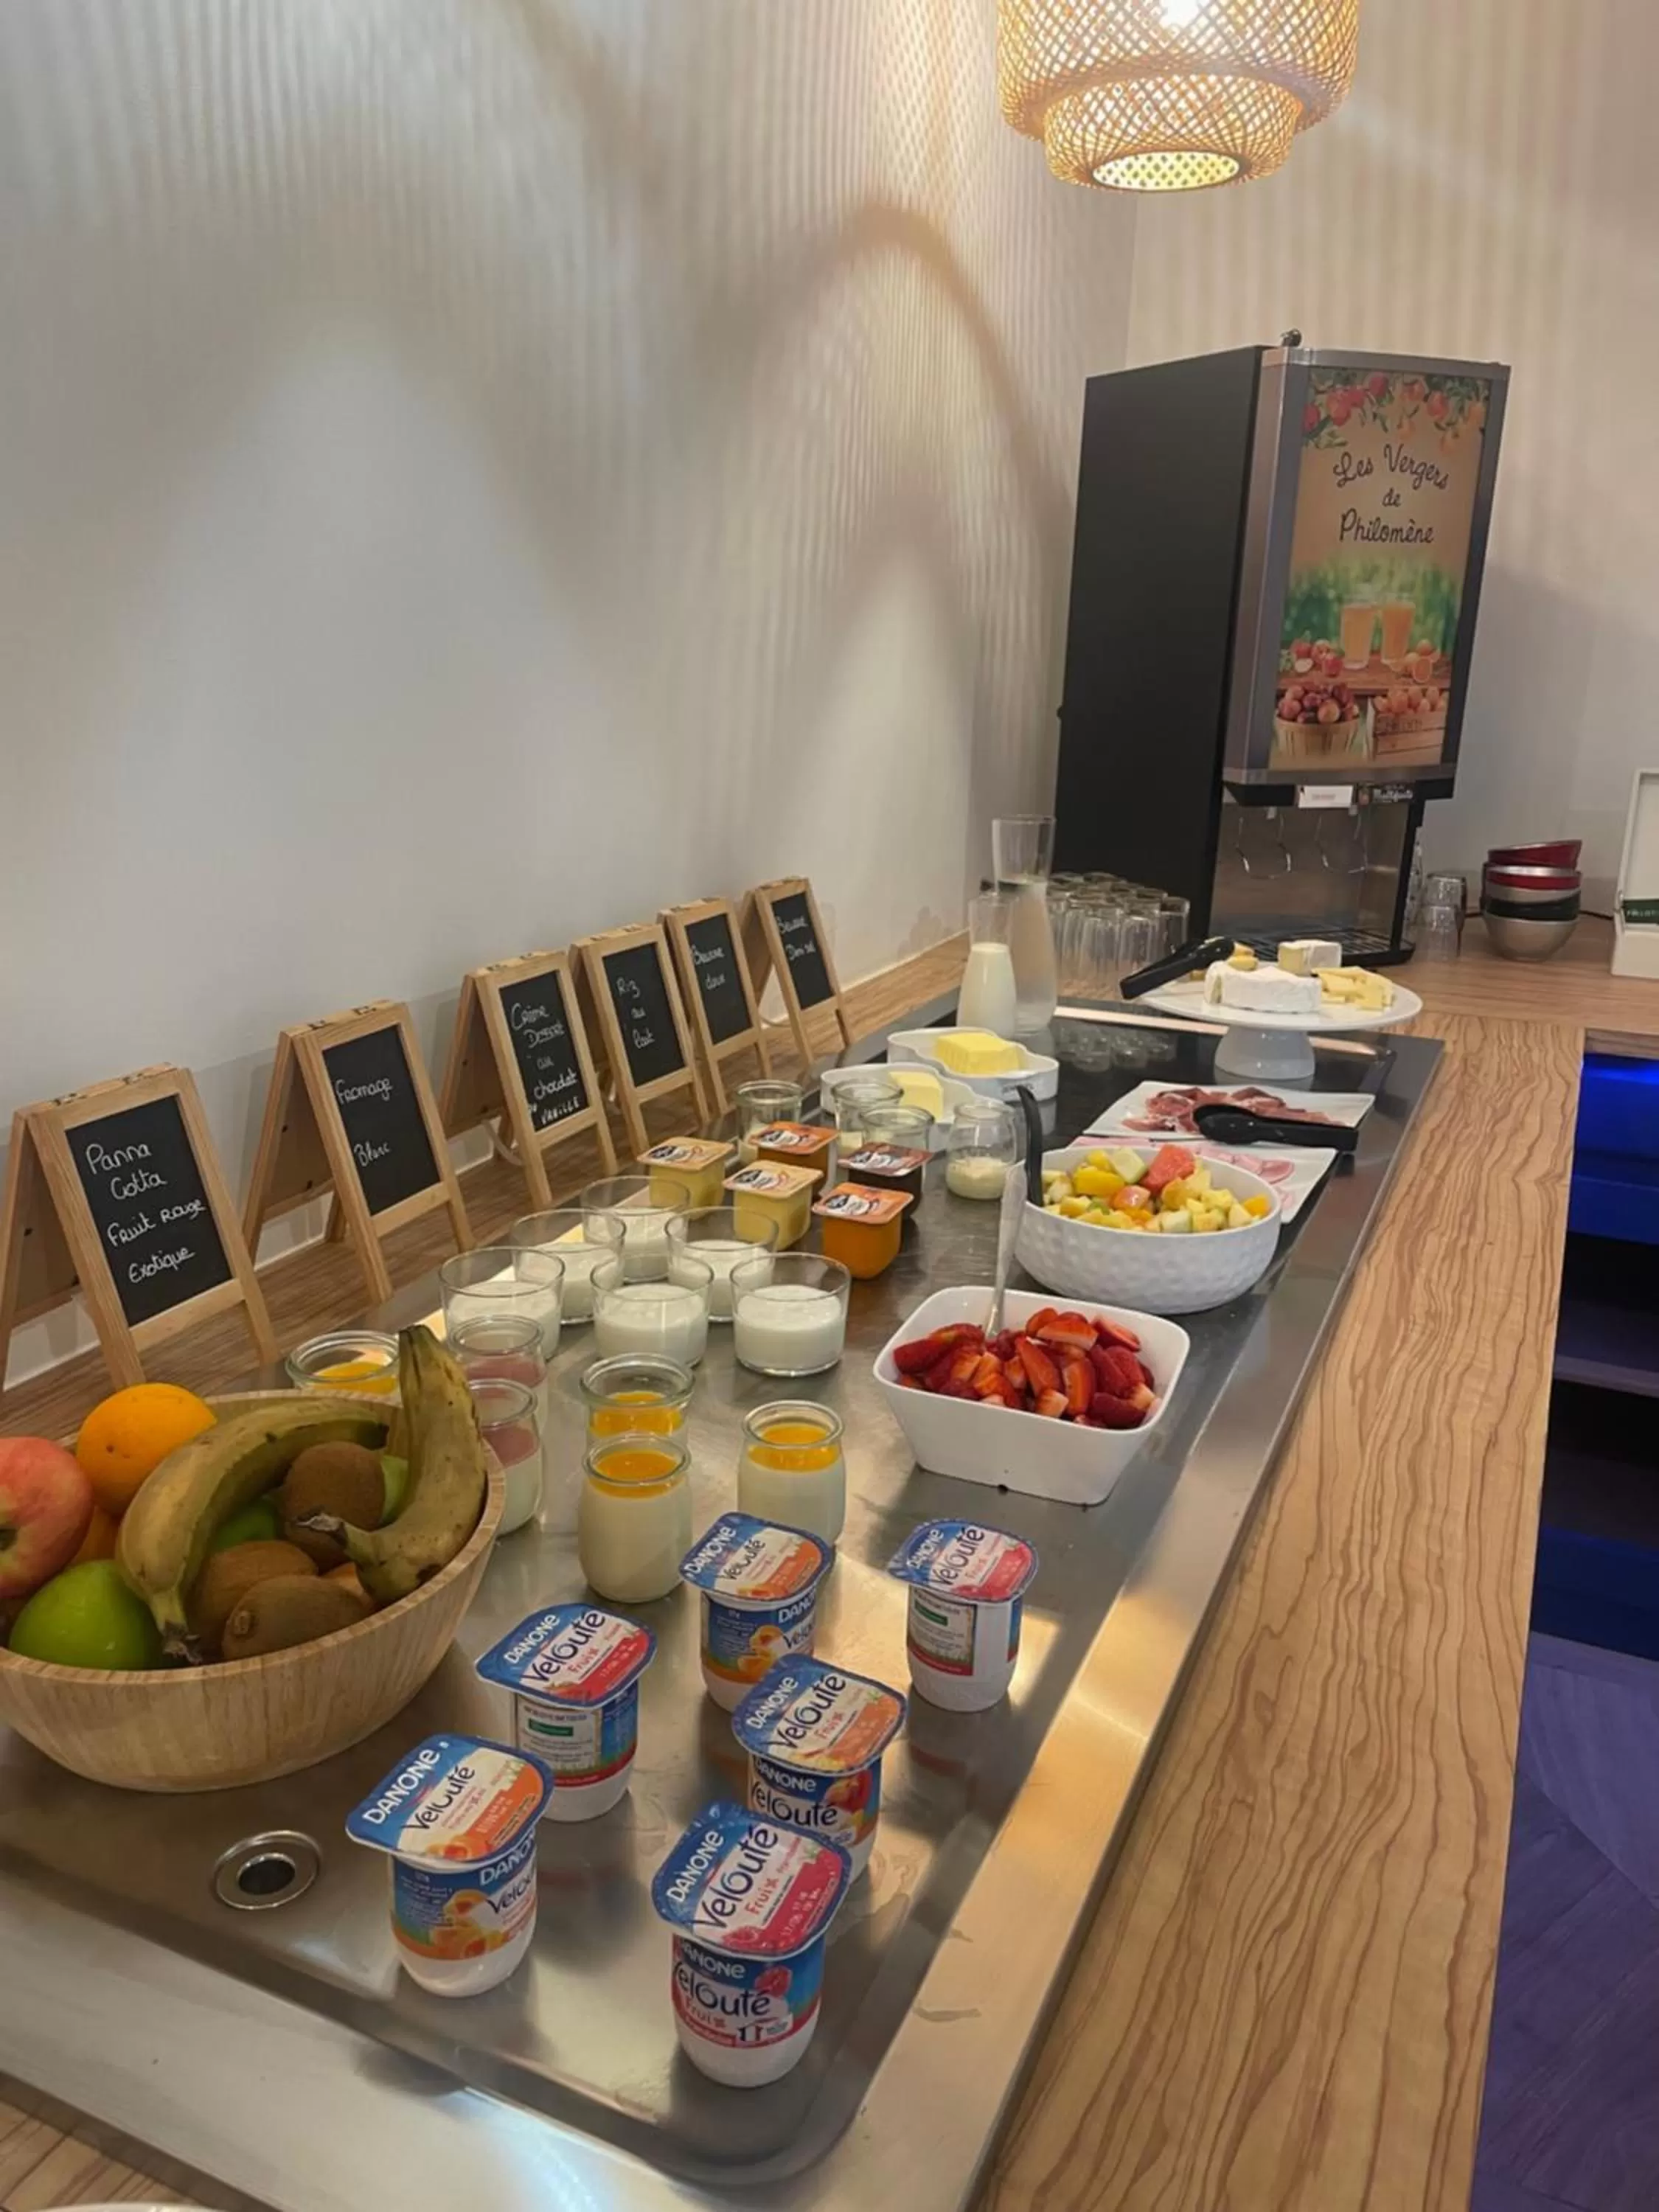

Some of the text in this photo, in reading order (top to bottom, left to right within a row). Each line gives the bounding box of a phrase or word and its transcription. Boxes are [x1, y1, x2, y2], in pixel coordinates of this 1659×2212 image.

[1333, 443, 1450, 490] Les Vergers
[1382, 487, 1402, 507] de
[1339, 508, 1434, 543] Philomène
[86, 1144, 153, 1175] Panna
[111, 1169, 168, 1200] Cotta
[128, 1247, 196, 1284] Exotique
